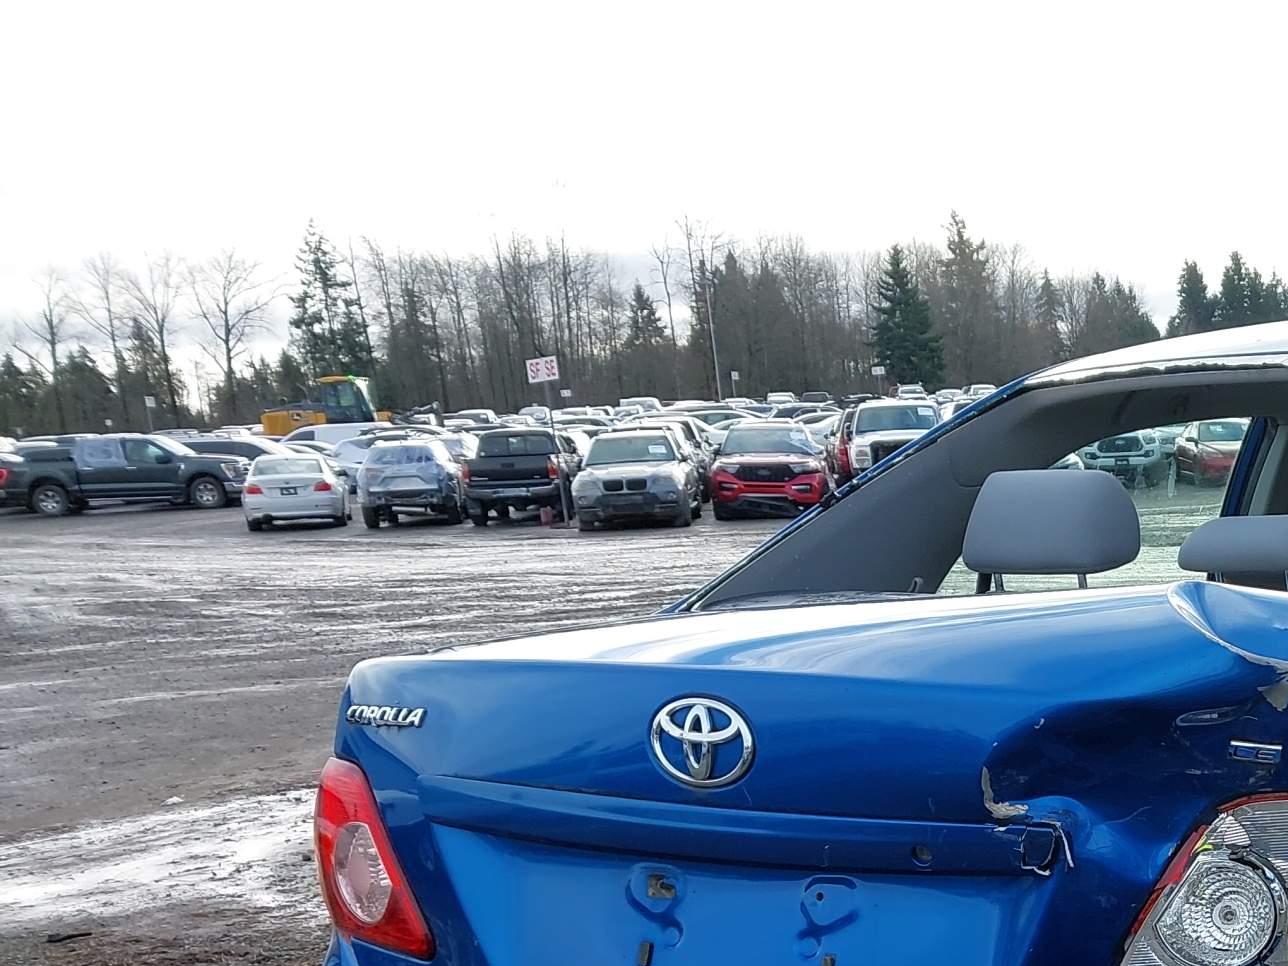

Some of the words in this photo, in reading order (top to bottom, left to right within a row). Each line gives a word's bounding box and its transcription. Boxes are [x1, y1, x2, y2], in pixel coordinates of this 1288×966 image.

[529, 361, 541, 379] SF
[544, 359, 557, 377] SE
[346, 705, 424, 727] COROLLA
